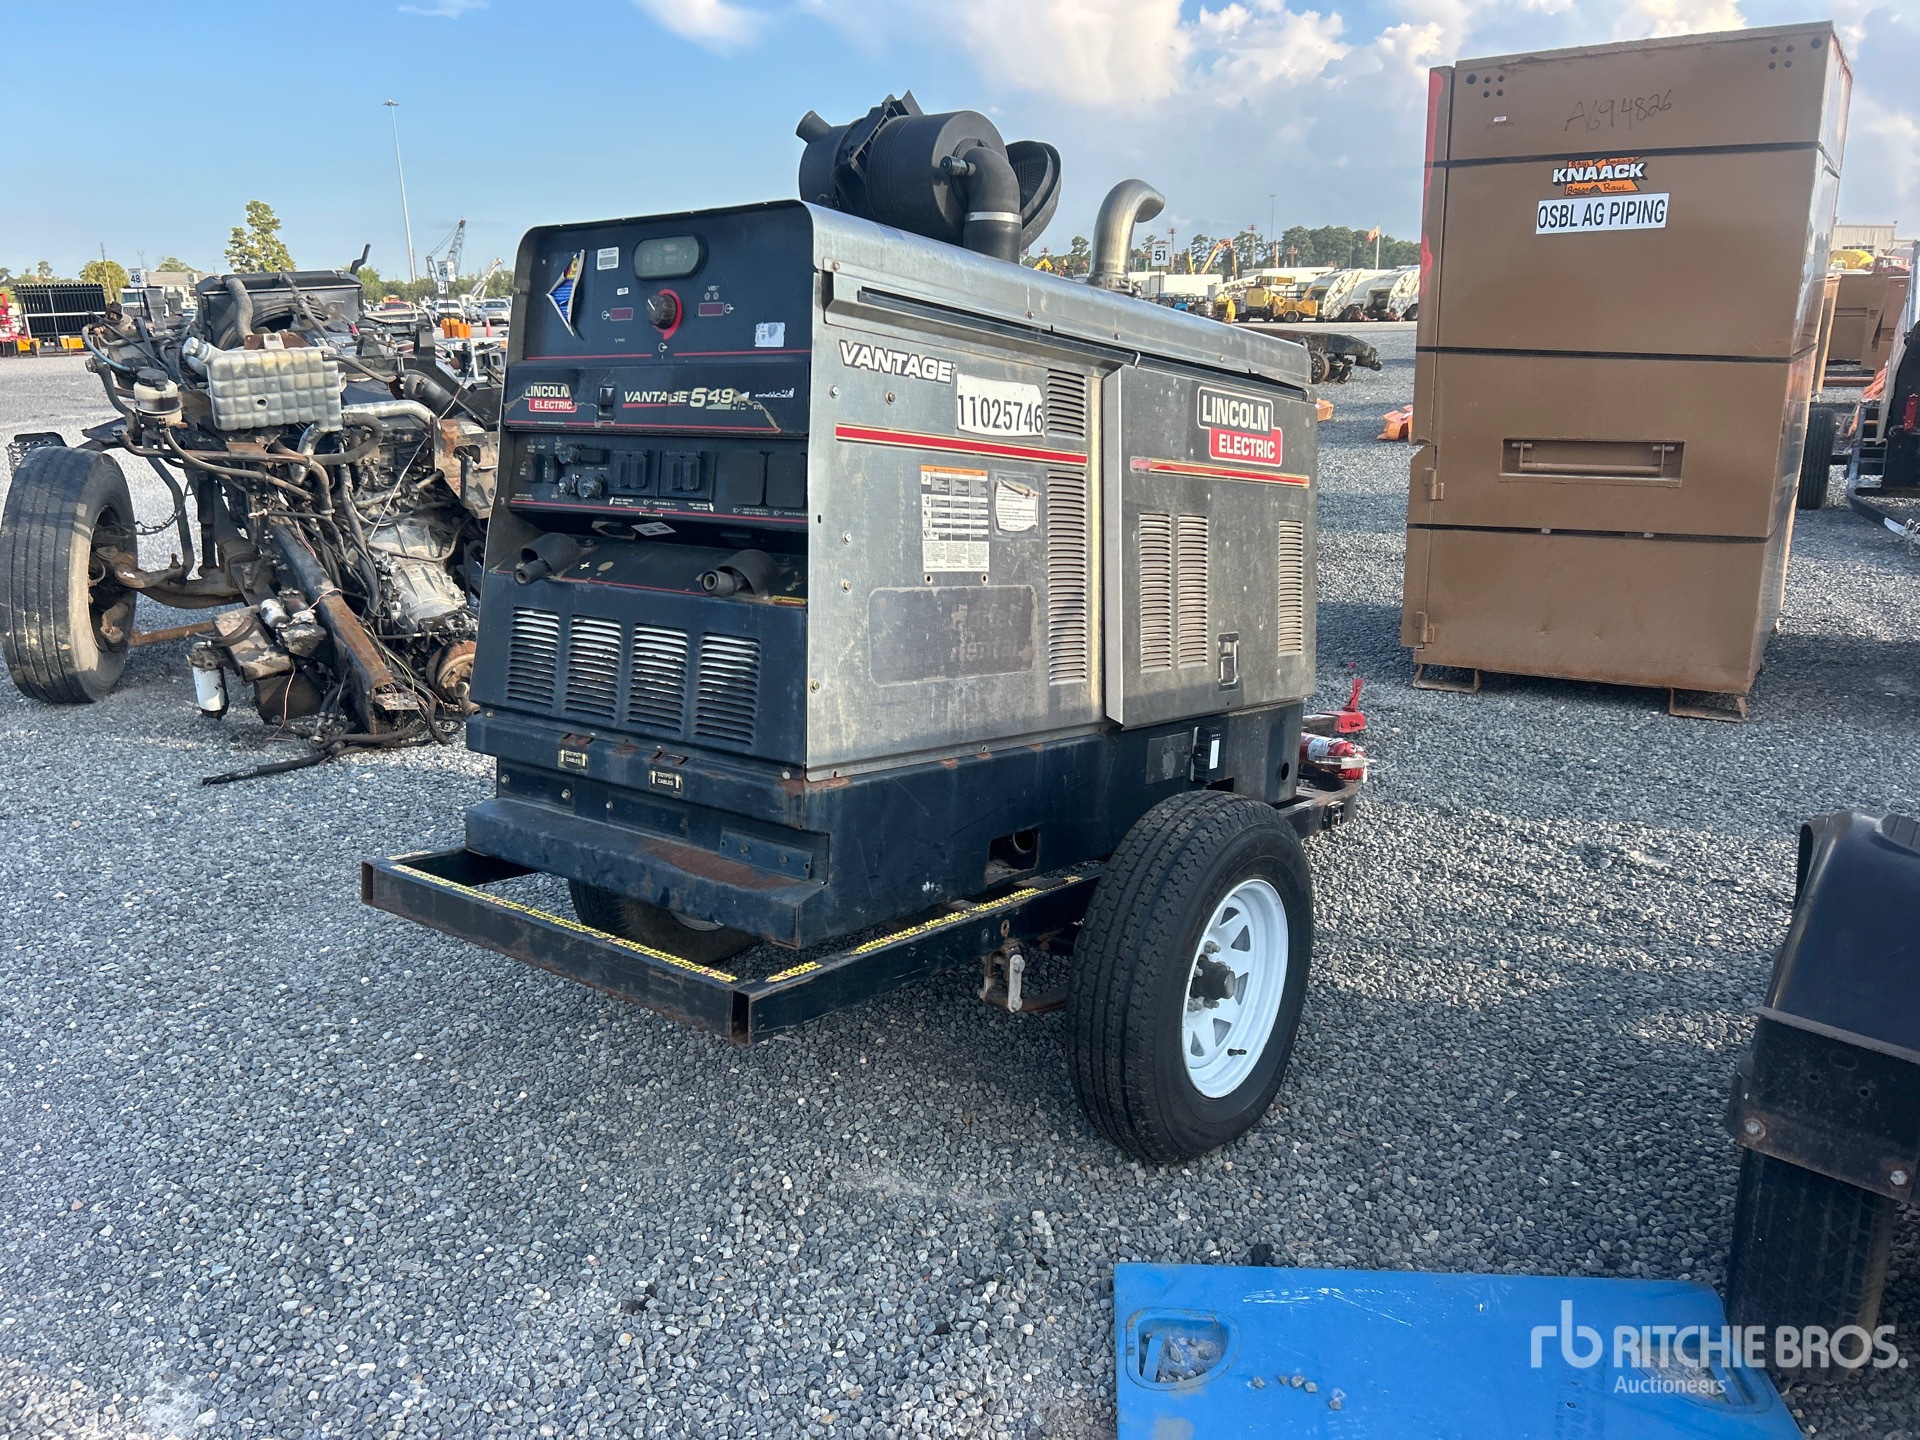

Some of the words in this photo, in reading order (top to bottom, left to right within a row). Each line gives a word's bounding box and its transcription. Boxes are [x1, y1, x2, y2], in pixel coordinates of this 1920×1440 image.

[1552, 162, 1646, 184] KNAACK
[1537, 204, 1578, 228] OSBL
[1582, 202, 1605, 227] AG
[1609, 199, 1666, 226] PIPING
[1154, 250, 1166, 261] 51
[130, 274, 141, 283] 48
[439, 267, 448, 277] 49
[839, 339, 955, 384] VANTAGE
[524, 385, 571, 398] LINCOLN
[624, 391, 688, 403] VANTAGE
[534, 400, 574, 410] ELECTRIC
[958, 394, 1044, 433] 11025746
[1202, 395, 1269, 432] LINCOLN
[1218, 433, 1276, 460] ELECTRIC
[657, 778, 674, 786] CABLES
